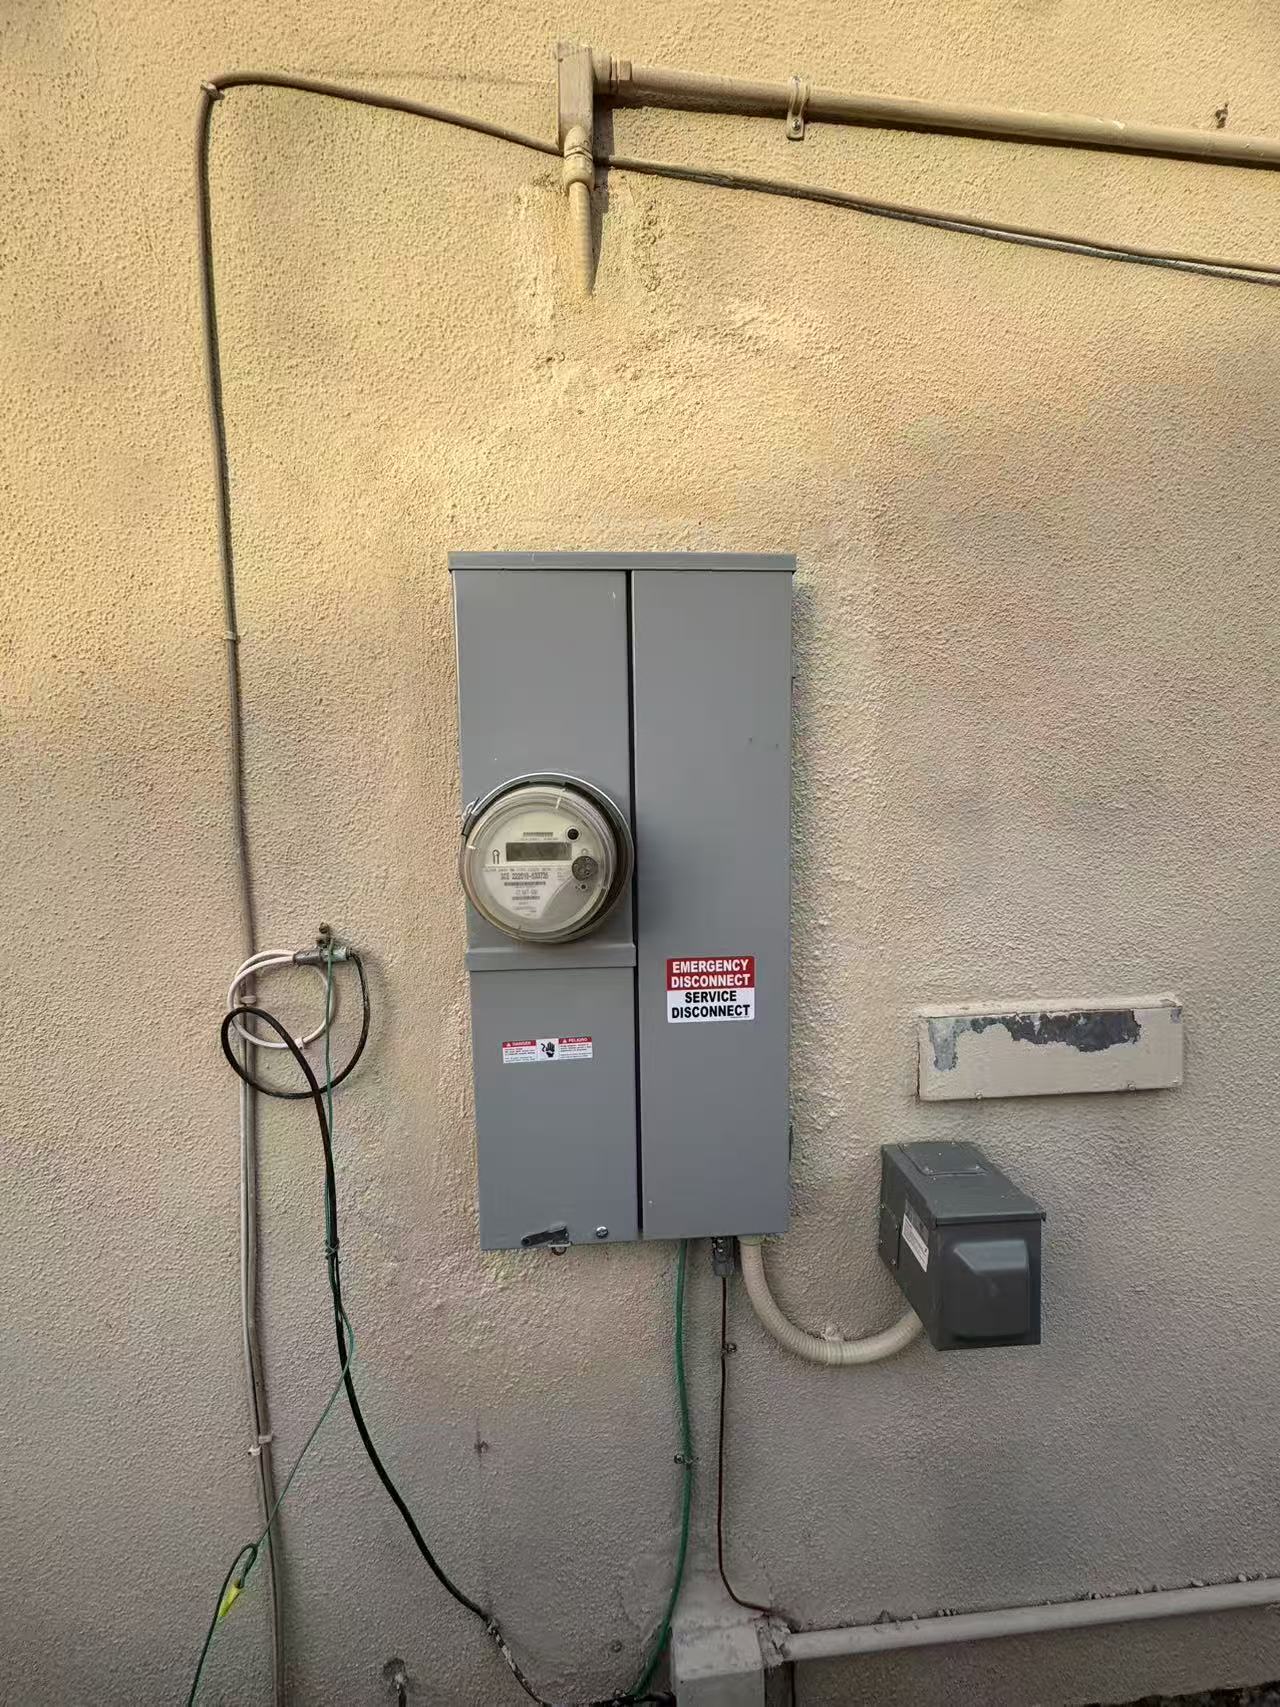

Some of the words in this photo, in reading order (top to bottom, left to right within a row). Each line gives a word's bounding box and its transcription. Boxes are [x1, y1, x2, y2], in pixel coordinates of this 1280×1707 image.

[672, 958, 749, 973] EMERGENCY
[671, 973, 751, 988] DISCONNECT
[685, 990, 737, 1003] SERVICE
[671, 1004, 751, 1019] DISCONNECT
